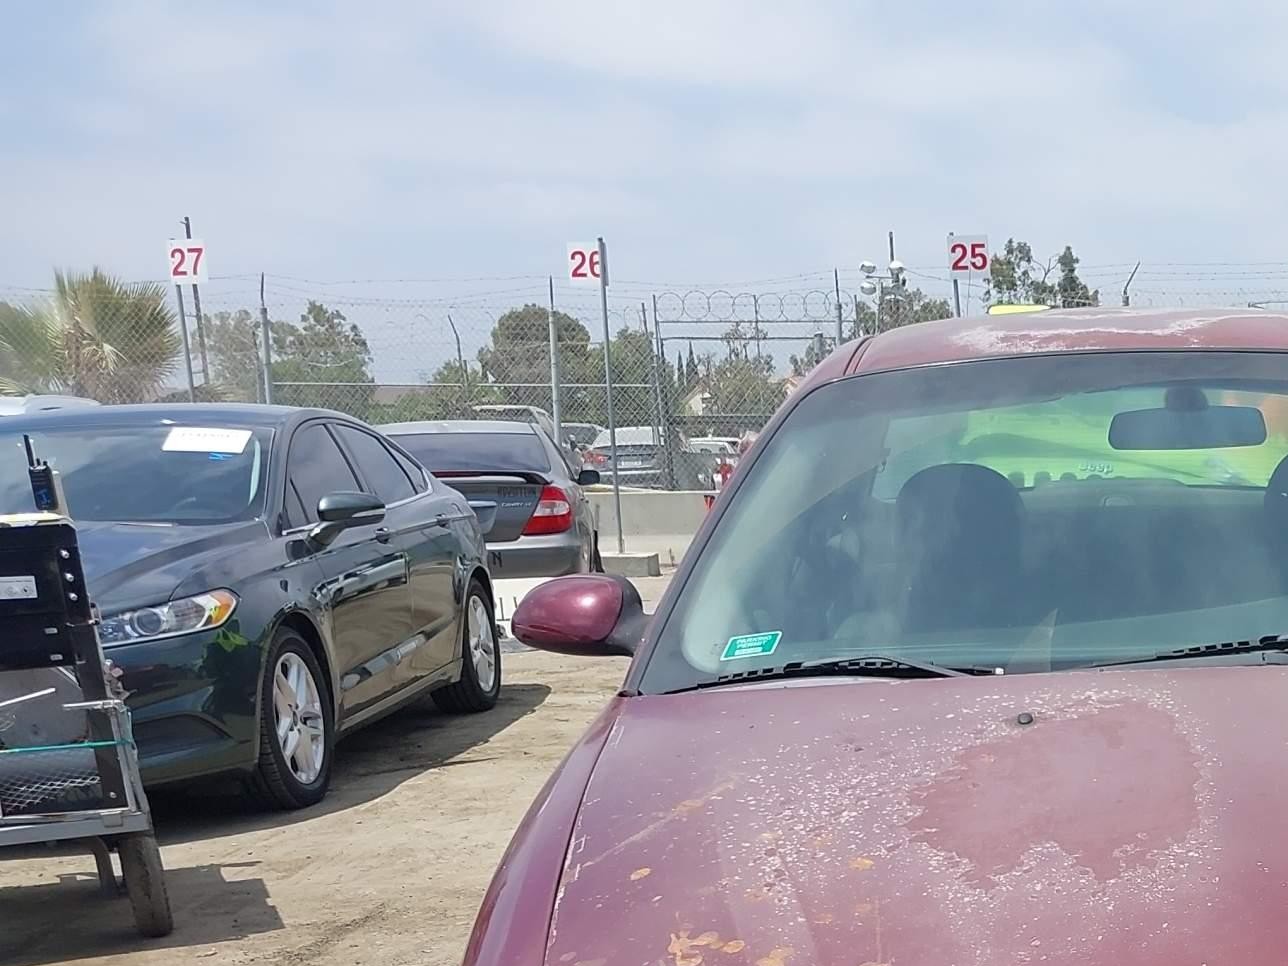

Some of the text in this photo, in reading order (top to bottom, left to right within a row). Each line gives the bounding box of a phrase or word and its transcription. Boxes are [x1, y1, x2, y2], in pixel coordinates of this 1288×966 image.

[171, 248, 203, 276] 27
[571, 251, 601, 278] 26
[951, 244, 988, 270] 25
